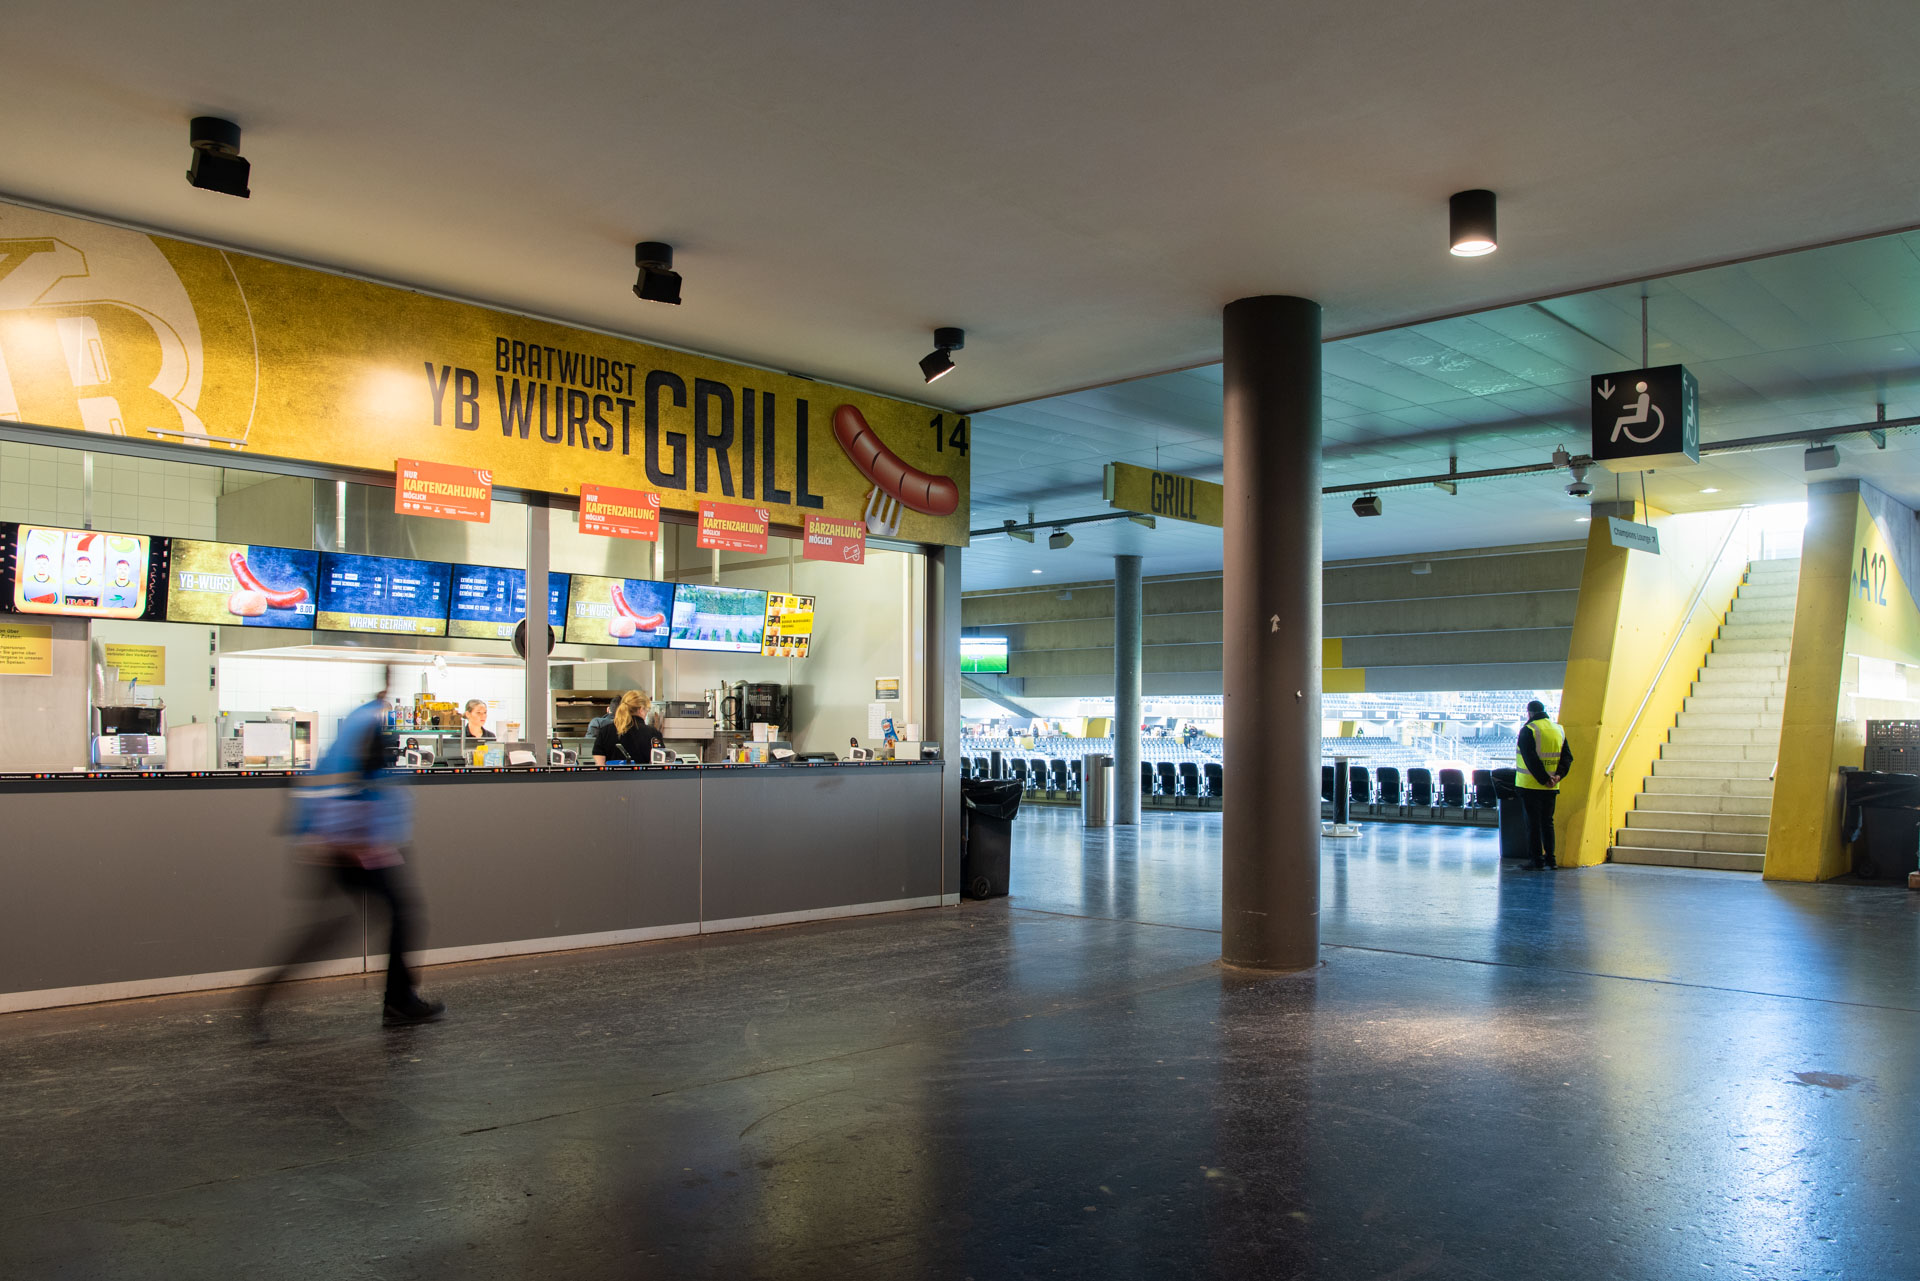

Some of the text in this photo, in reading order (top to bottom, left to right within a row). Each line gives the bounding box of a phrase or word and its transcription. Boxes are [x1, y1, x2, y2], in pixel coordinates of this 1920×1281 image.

[496, 337, 636, 395] BRATWURST
[424, 361, 636, 455] YB WURST
[645, 370, 823, 509] GRILL
[930, 414, 968, 456] 14
[403, 470, 418, 479] NUR
[403, 479, 486, 500] KARTENZAHLUNG
[403, 491, 427, 501] MÖGLICH
[586, 494, 598, 502] NUR
[1151, 472, 1197, 520] GRILL
[586, 502, 655, 520] KARTENZAHLUNG
[703, 518, 765, 534] KARTENZAHLUNG
[809, 521, 862, 539] BARZAHLUNG
[808, 534, 833, 545] MÖGLICH
[179, 573, 236, 592] YB-WURST
[1859, 546, 1887, 607] A12
[575, 602, 615, 618] YB-WURST
[379, 617, 417, 631] GETRÄNKE
